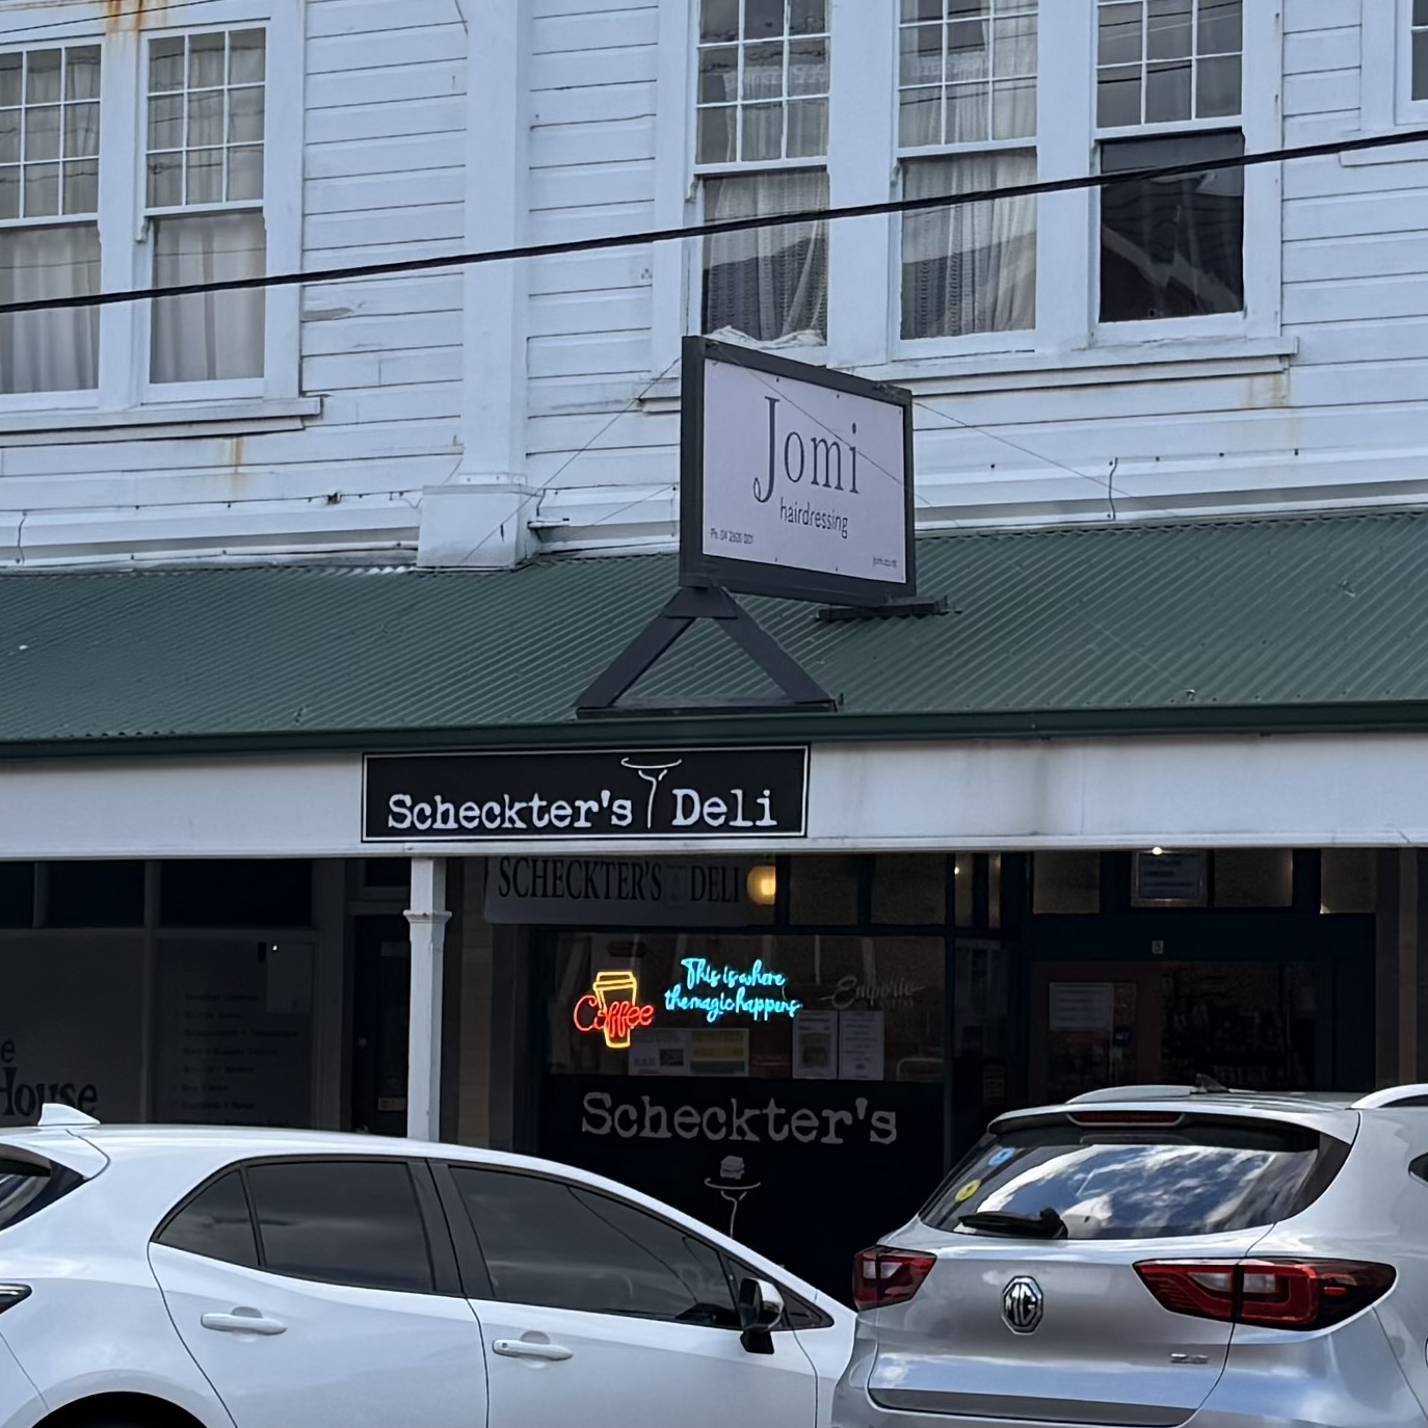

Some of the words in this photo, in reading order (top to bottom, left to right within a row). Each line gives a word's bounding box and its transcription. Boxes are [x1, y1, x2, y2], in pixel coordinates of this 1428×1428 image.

[753, 396, 859, 503] Jomi
[780, 498, 848, 539] hairdressing
[388, 790, 633, 831] Scheckter's
[671, 788, 778, 827] Deli
[498, 857, 663, 900] SCHECKTER'S
[690, 865, 740, 903] DELI
[681, 958, 721, 989] This
[723, 966, 738, 988] is
[573, 995, 655, 1037] Coffee
[664, 984, 689, 1010] the
[689, 992, 735, 1023] magic
[735, 986, 803, 1021] happens
[582, 1092, 897, 1145] Scheckter's
